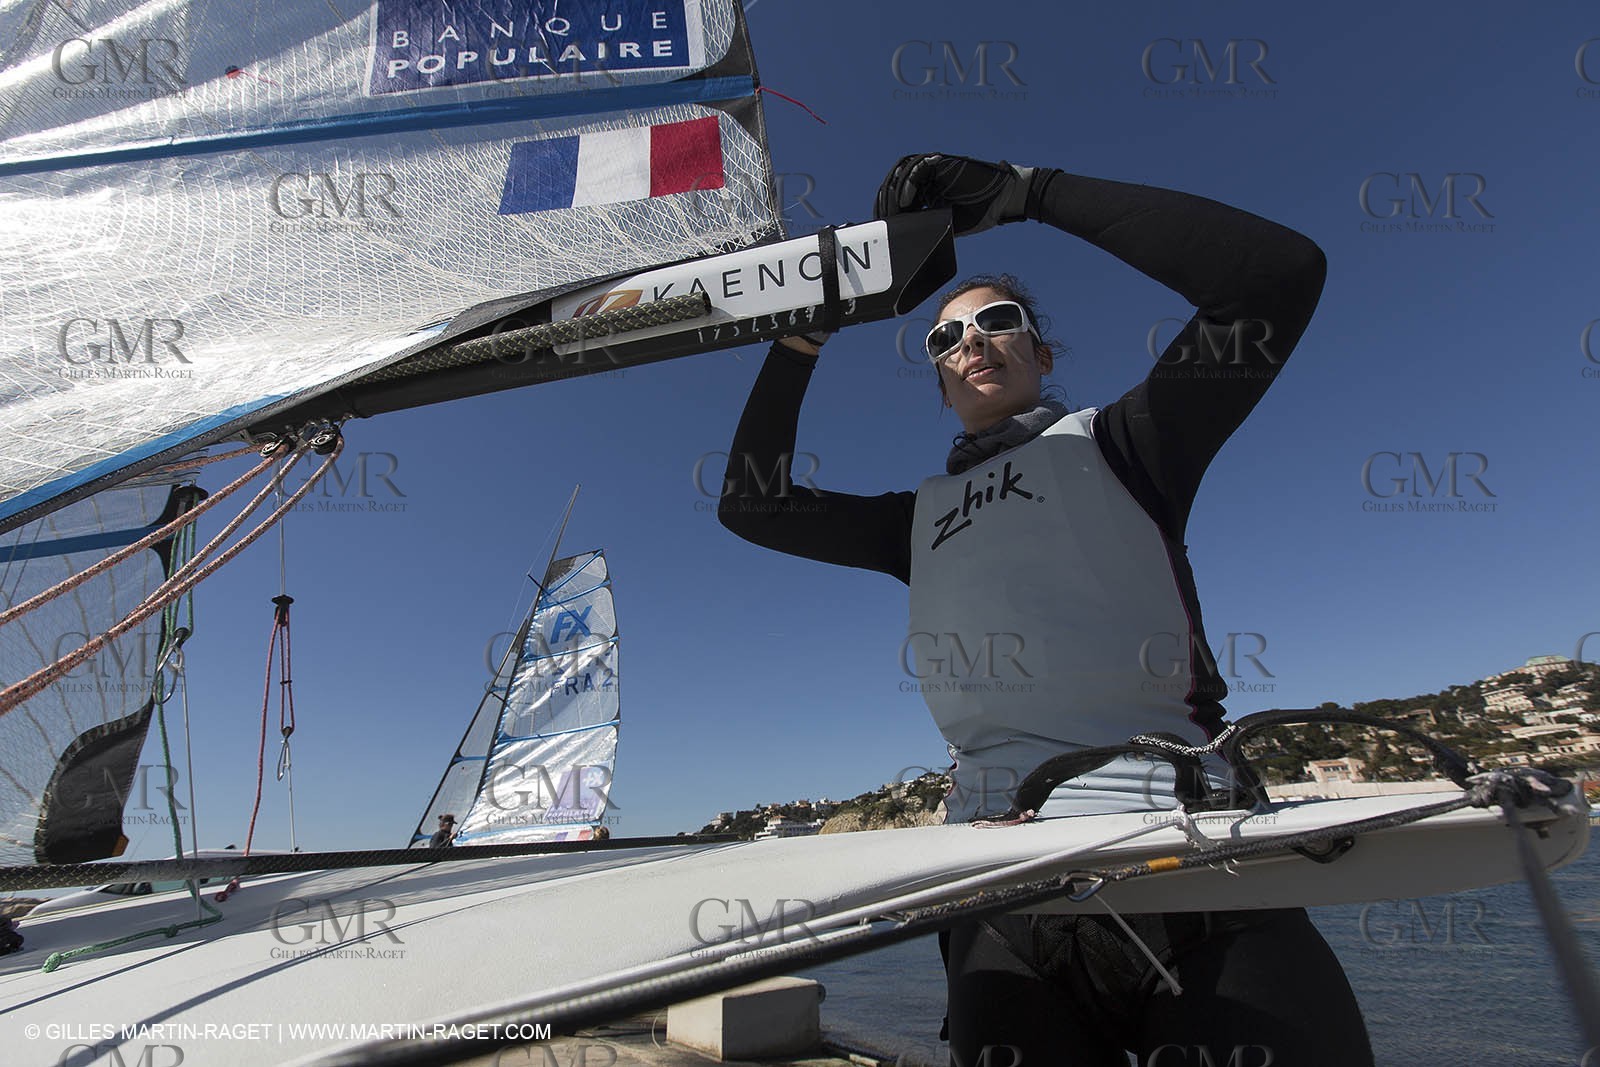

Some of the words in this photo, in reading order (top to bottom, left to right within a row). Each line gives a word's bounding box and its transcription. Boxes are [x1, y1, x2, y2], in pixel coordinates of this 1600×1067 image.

[392, 12, 667, 48] BANQUE
[387, 41, 672, 78] POPULAIRE
[653, 241, 871, 301] KAENON
[550, 605, 593, 644] FX
